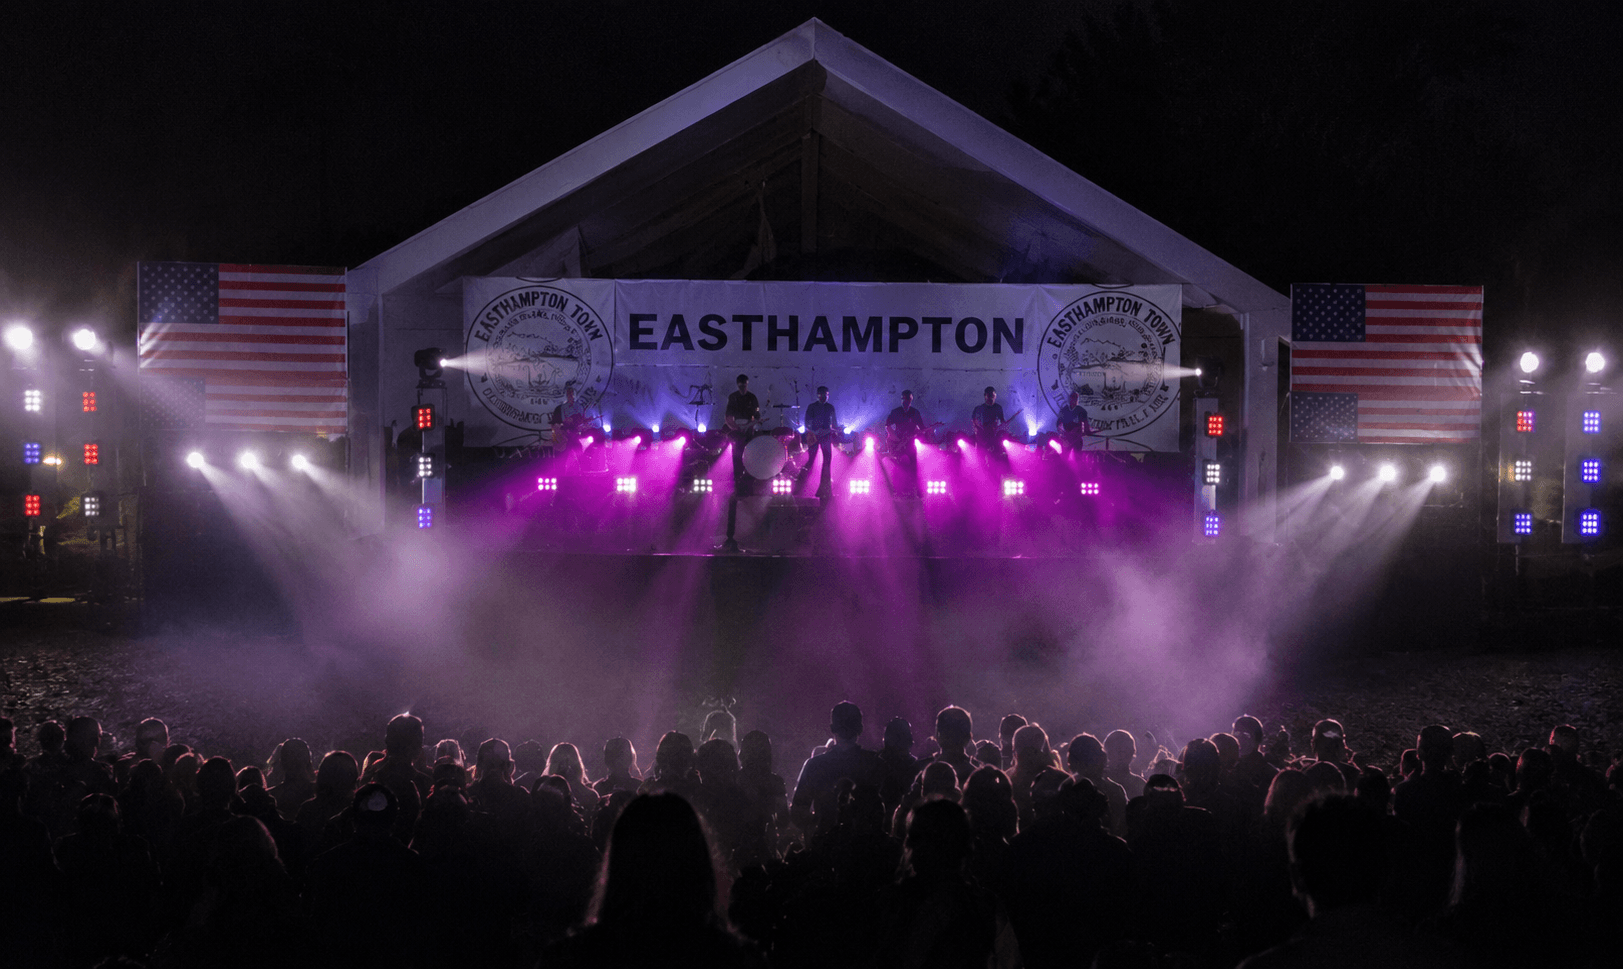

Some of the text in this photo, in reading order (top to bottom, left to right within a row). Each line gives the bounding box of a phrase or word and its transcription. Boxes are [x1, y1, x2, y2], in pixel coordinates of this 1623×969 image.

[475, 291, 568, 342] EASTHAMPTON
[570, 304, 603, 341] TOWN
[629, 314, 1024, 354] EASTHAMPTON
[1047, 297, 1175, 348] EASTHAMPTON TOWN
